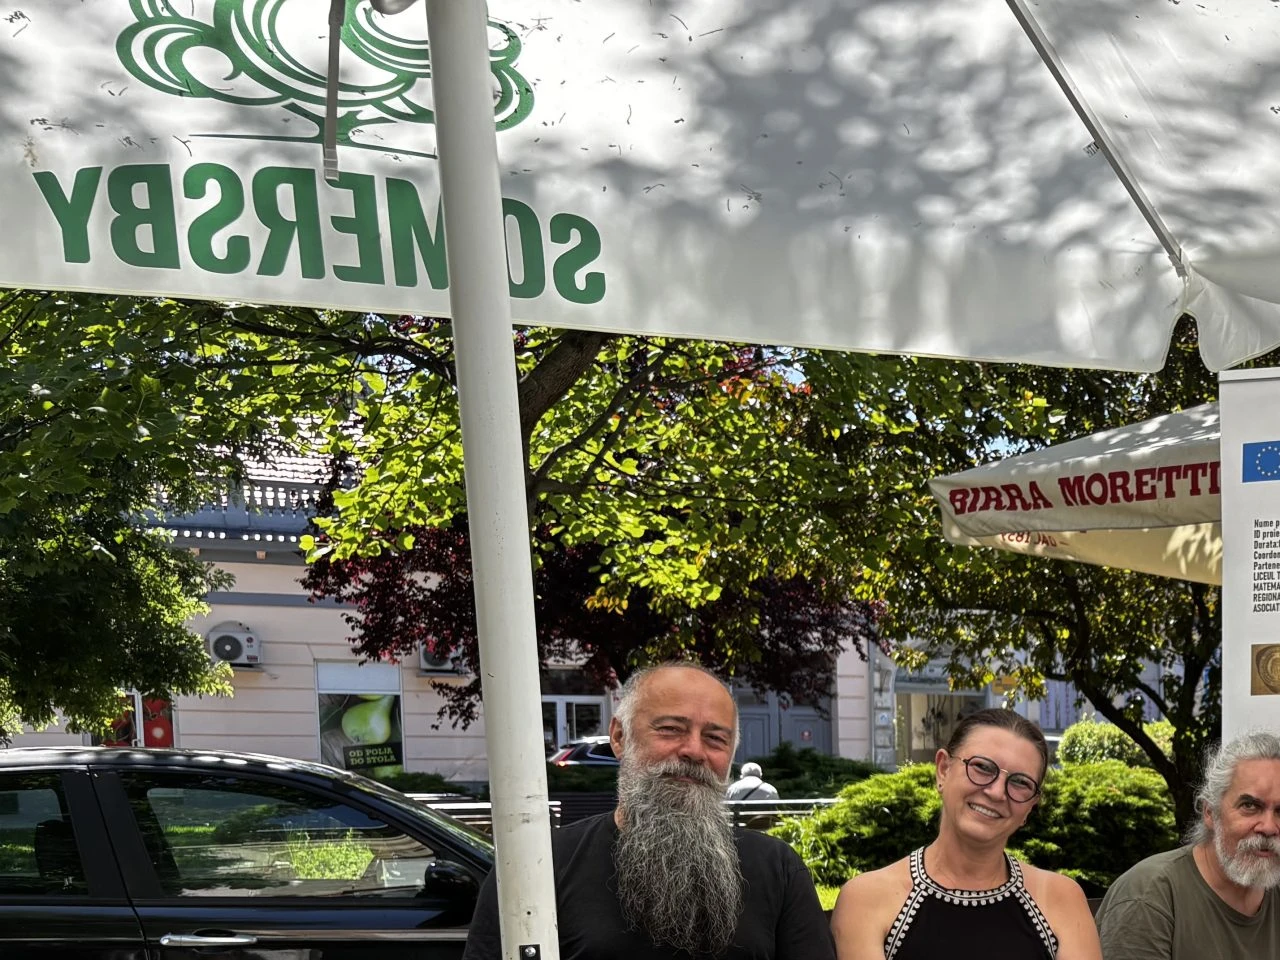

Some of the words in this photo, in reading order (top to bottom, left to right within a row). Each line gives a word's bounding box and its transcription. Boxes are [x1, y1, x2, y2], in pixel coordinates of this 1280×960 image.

[949, 481, 1053, 515] BIRRA
[1058, 461, 1221, 507] MORETTI
[1254, 519, 1273, 528] Nume
[1254, 530, 1260, 538] ID
[1254, 571, 1275, 580] LICEUL
